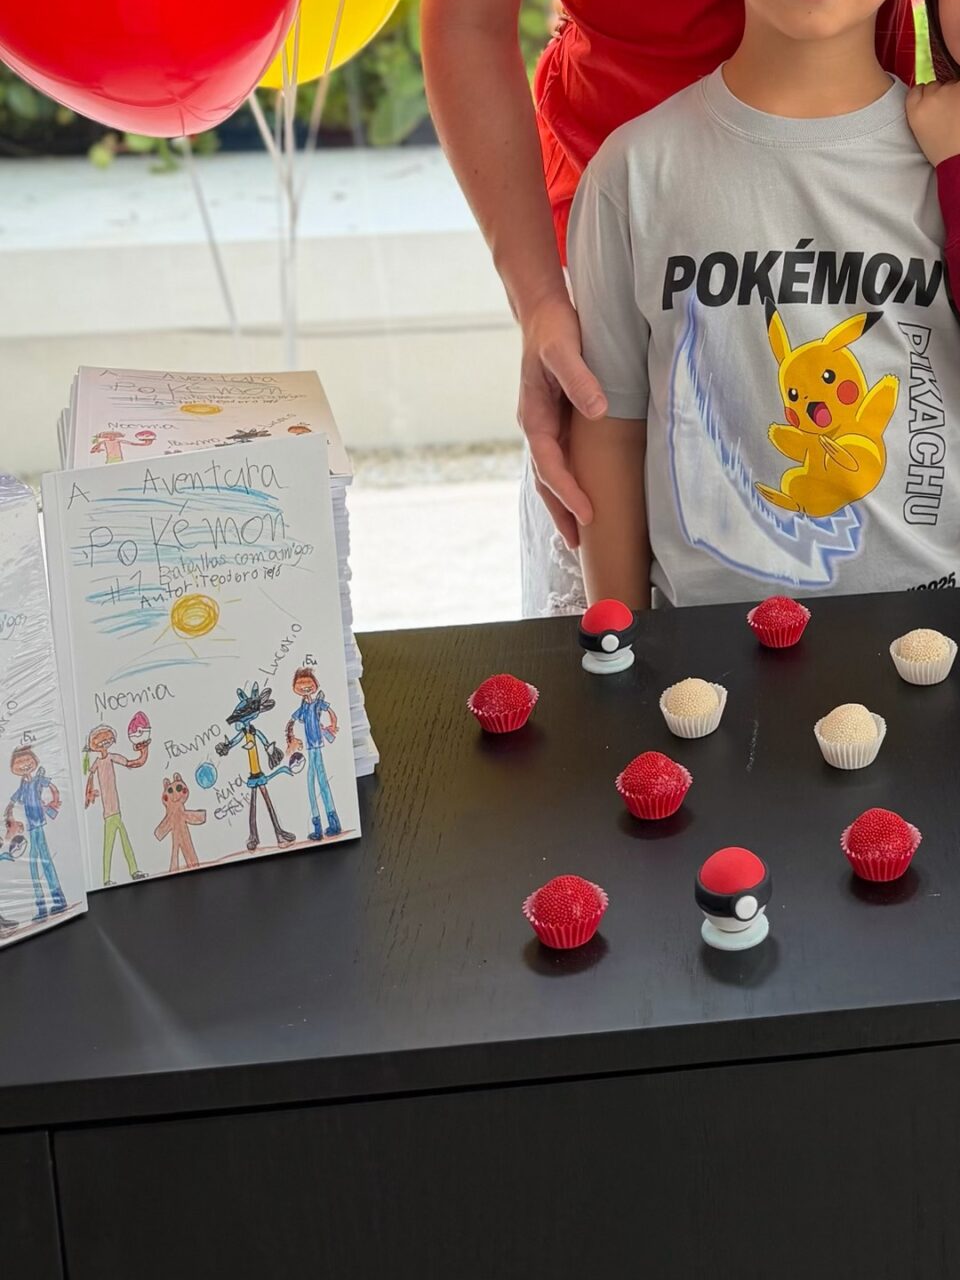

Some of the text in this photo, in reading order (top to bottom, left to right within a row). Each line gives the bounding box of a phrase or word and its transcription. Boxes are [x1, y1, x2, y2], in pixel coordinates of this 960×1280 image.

[662, 238, 943, 310] POKÉMON
[898, 321, 946, 526] PIKACHU
[68, 457, 288, 510] A Aventura
[94, 682, 175, 713] Noemia
